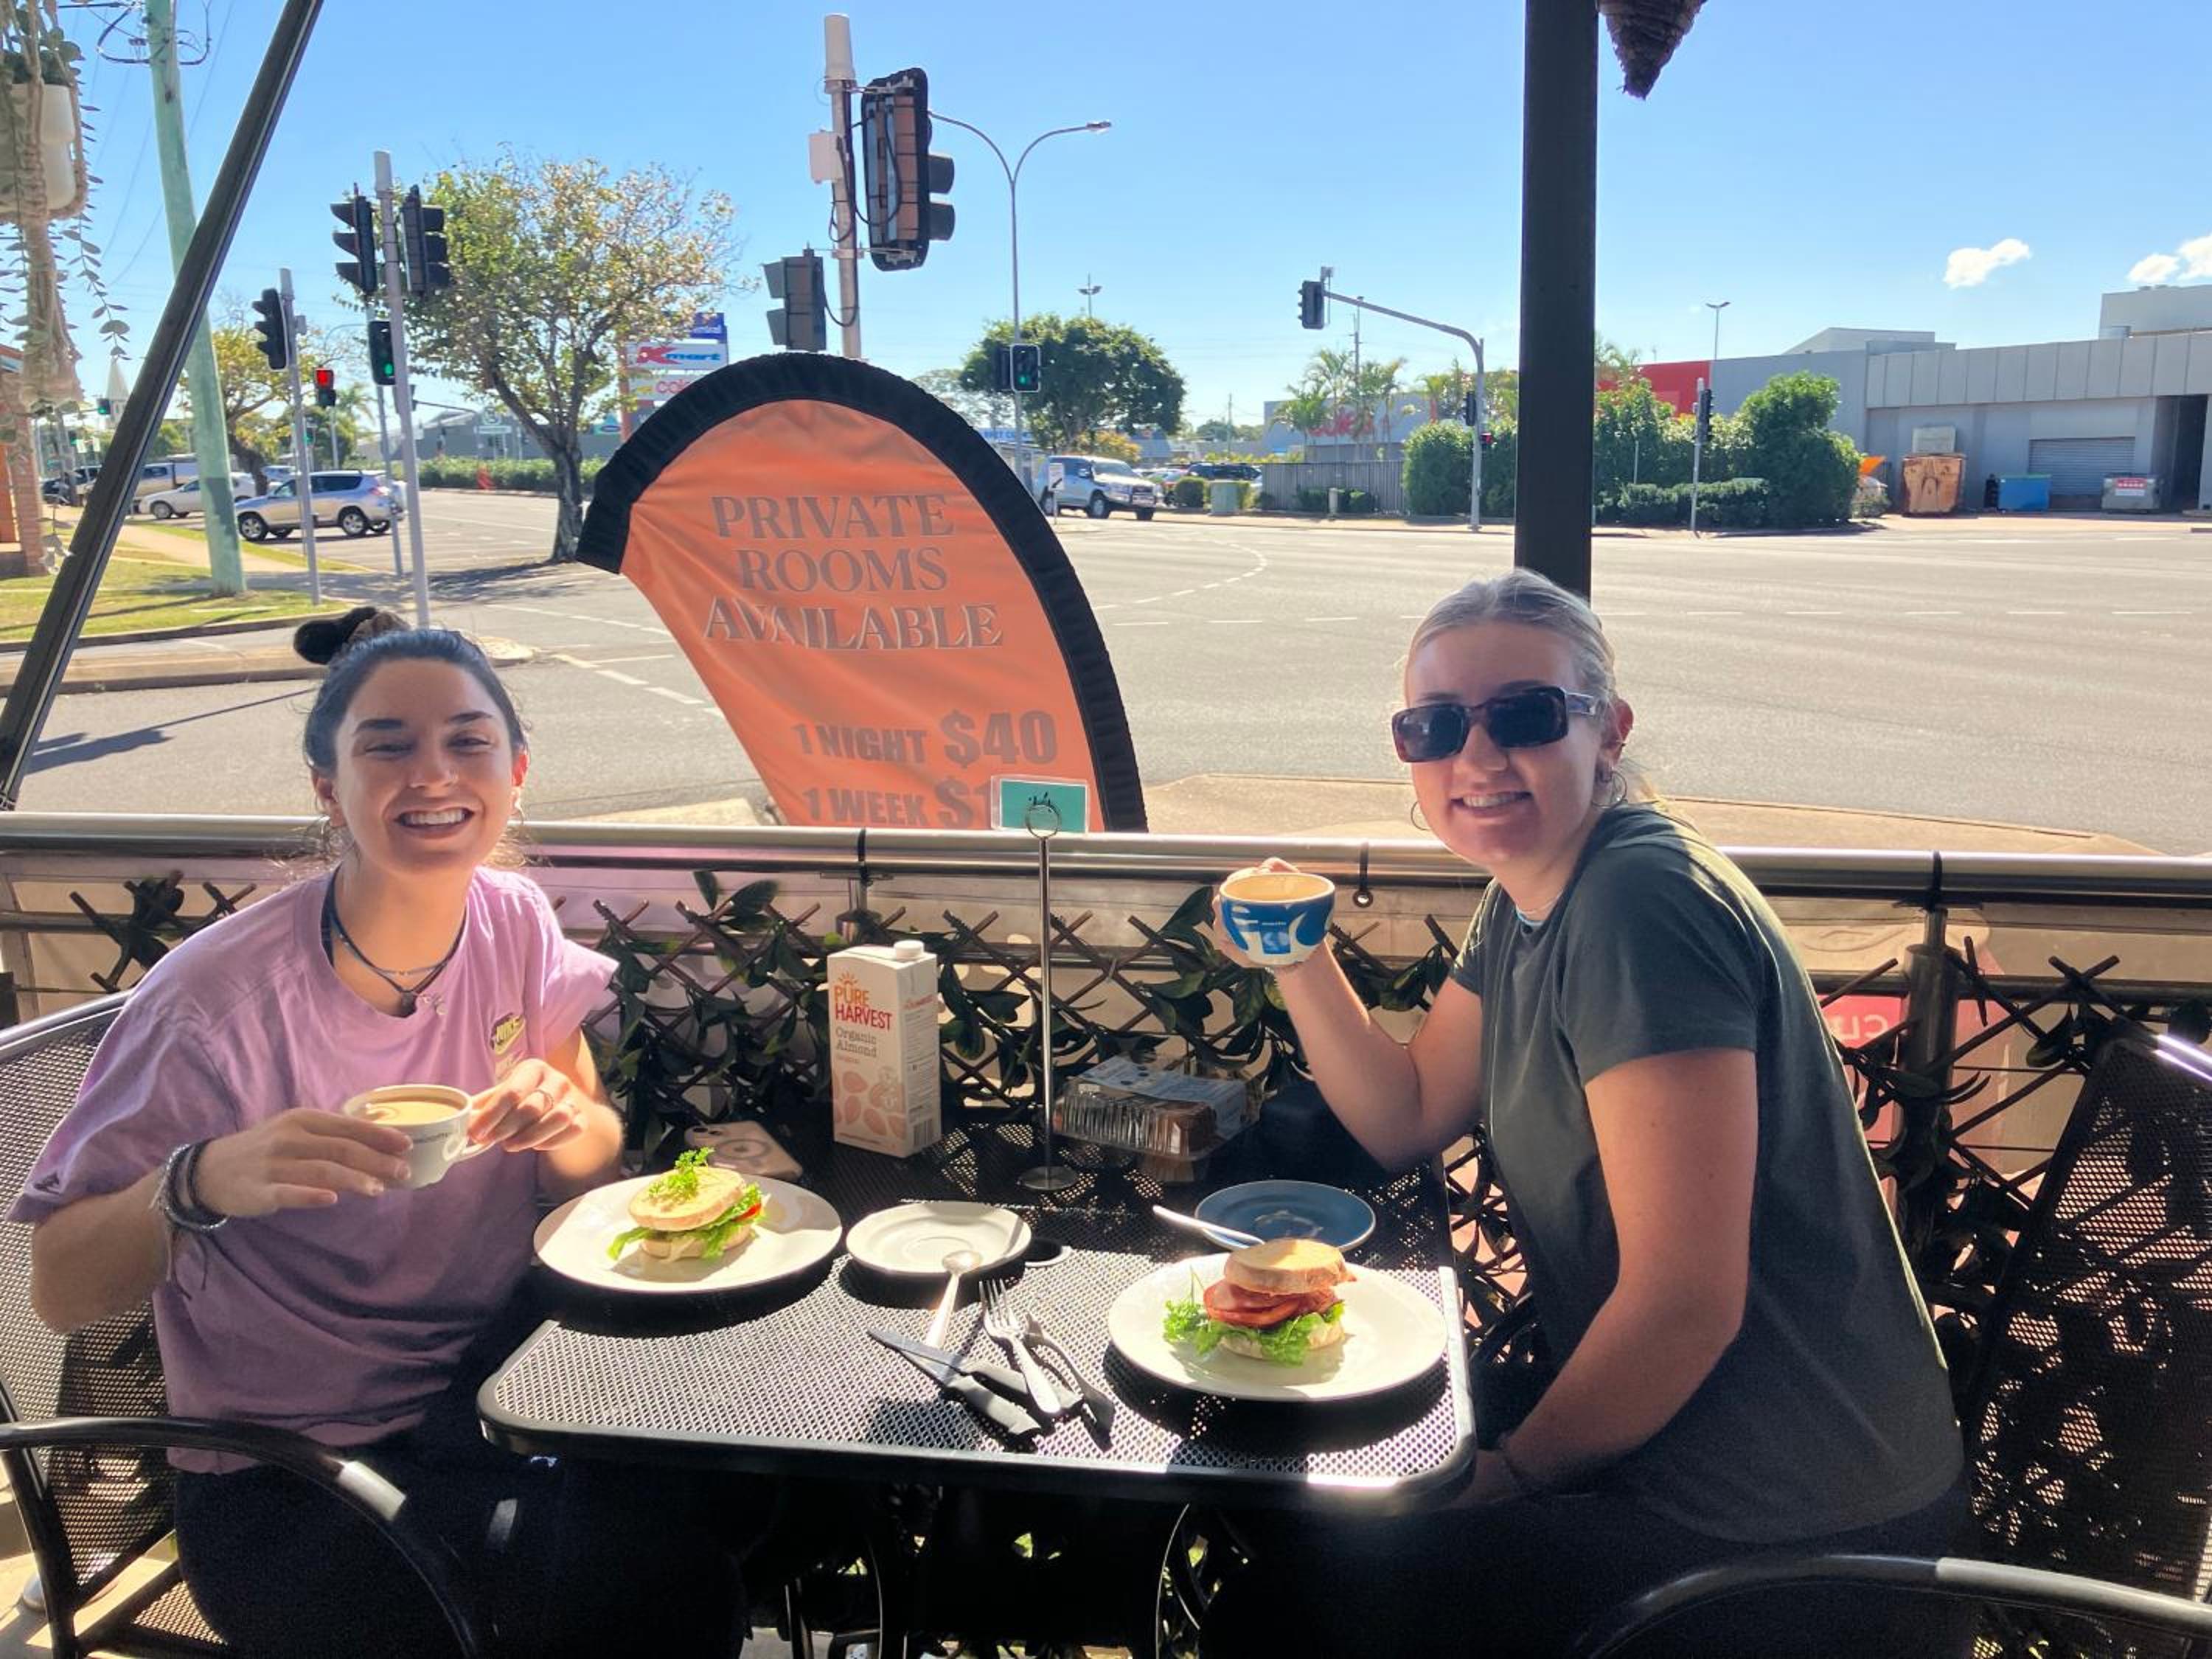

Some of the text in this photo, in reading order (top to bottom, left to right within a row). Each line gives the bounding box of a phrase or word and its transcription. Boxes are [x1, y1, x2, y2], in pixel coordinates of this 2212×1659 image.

[637, 346, 720, 365] Kmart
[710, 494, 955, 539] PRIVATE
[733, 546, 949, 591] ROOMS
[704, 596, 1004, 650] AVAILABLE
[790, 709, 1058, 769] 1 NIGHT $40
[802, 787, 821, 822] 1
[827, 787, 928, 827] WEEK
[834, 982, 869, 1006] PURE
[835, 1002, 893, 1031] HARVEST
[835, 1026, 877, 1045] Organic
[835, 1039, 877, 1057] Almond
